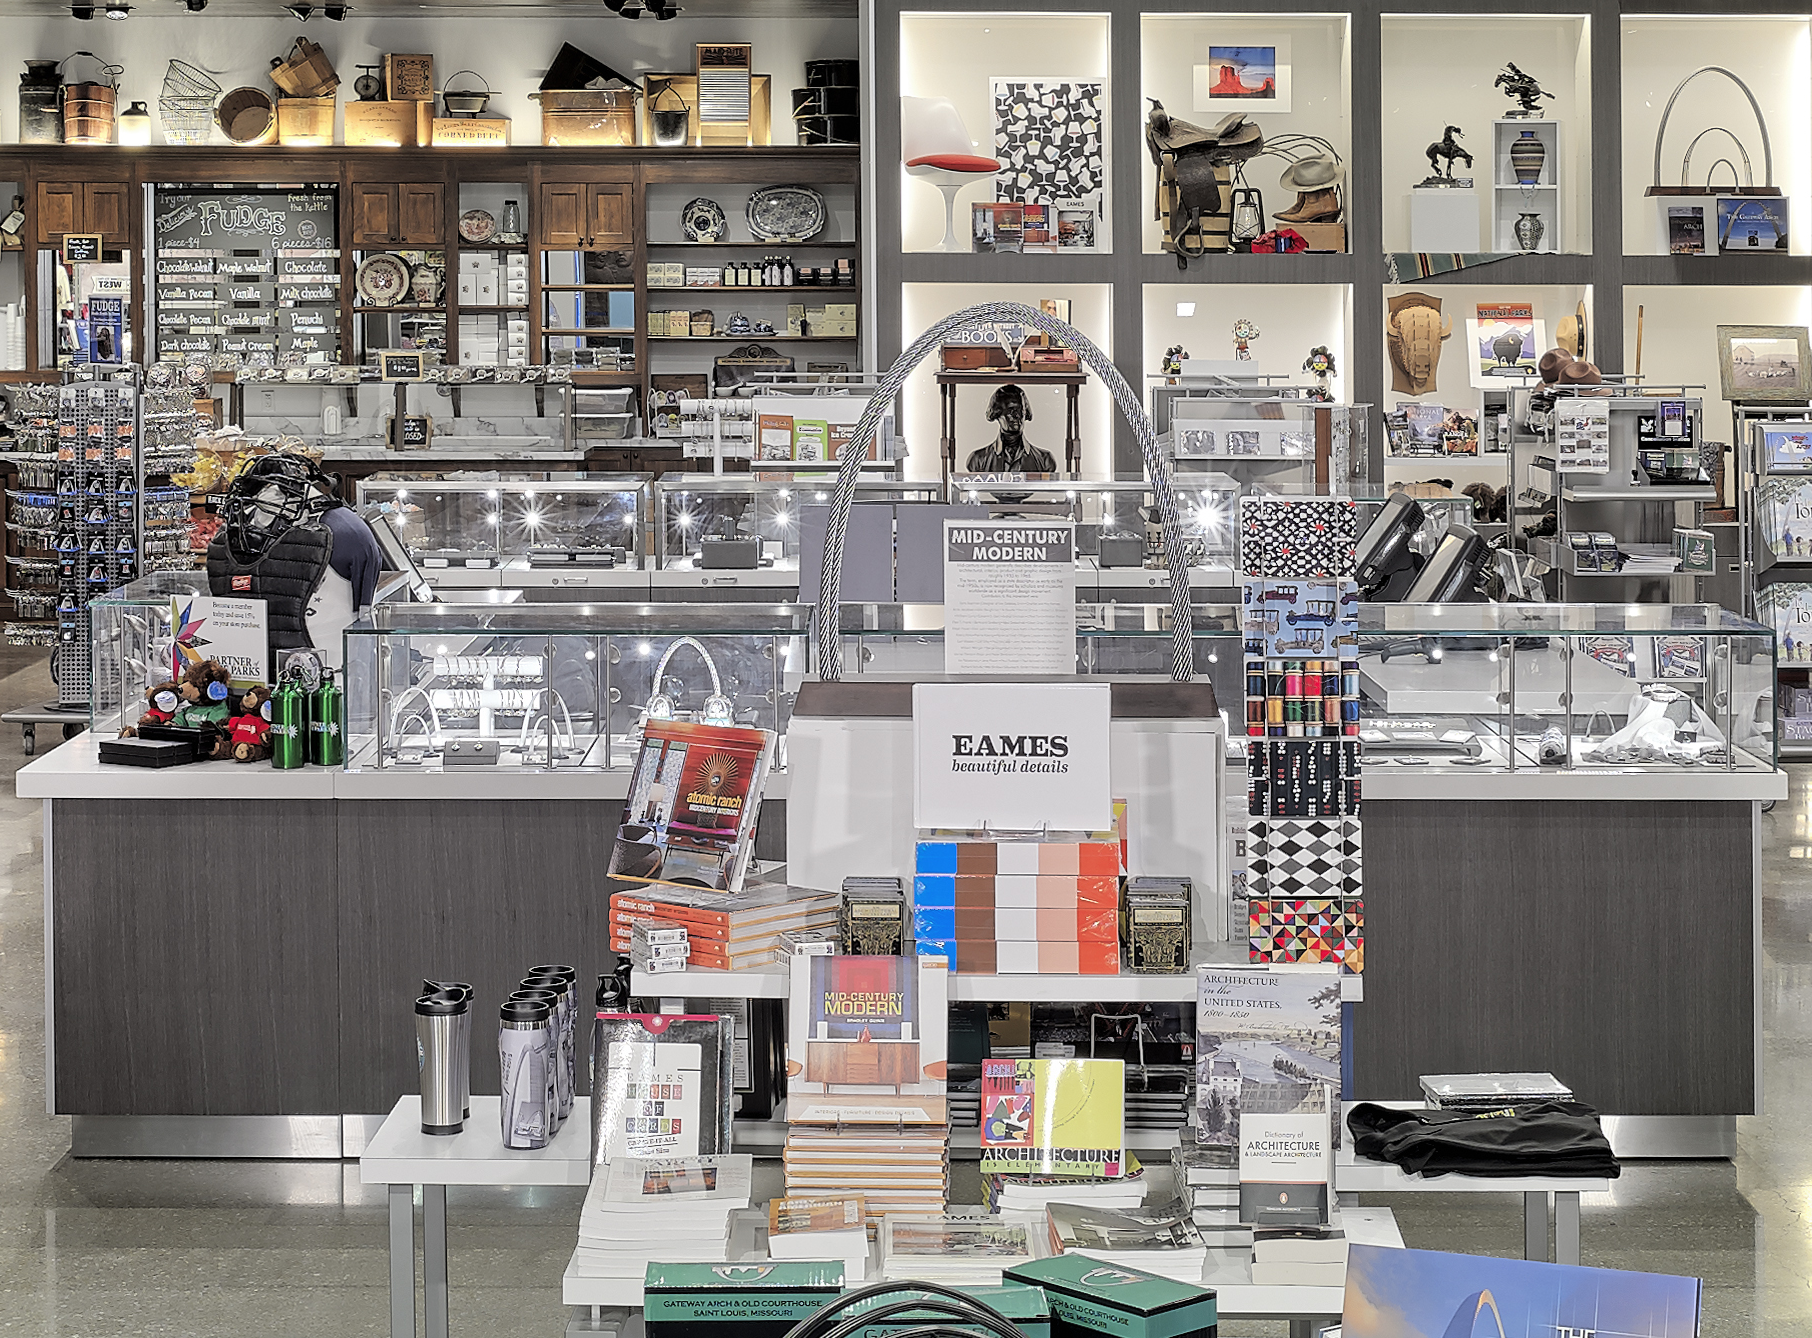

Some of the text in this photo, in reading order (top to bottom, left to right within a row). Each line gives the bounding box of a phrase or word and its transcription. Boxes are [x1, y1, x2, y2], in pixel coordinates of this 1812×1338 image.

[159, 192, 174, 207] Try
[290, 202, 302, 212] the
[197, 200, 286, 236] FUDGE
[158, 237, 163, 247] 1
[271, 237, 279, 248] 6
[216, 262, 243, 275] Maple
[285, 260, 327, 273] Chocolate
[158, 287, 186, 299] Vanilla
[228, 286, 261, 299] Vanilla
[280, 285, 300, 299] Milk
[90, 300, 120, 312] FUDGE
[160, 340, 179, 351] Dark
[221, 337, 246, 351] Peanut
[290, 337, 318, 351] Maple
[951, 529, 1068, 544] MID-CENTURY
[972, 546, 1047, 560] MODERN
[951, 733, 1069, 758] EAMES
[951, 758, 1068, 776] beautiful details
[686, 791, 742, 809] atomic ranch
[1204, 984, 1231, 996] in the
[824, 991, 904, 1003] MID-CENTURY
[1204, 997, 1282, 1010] UNITED STATES,
[824, 1001, 903, 1015] MODERN
[1264, 1130, 1304, 1139] Dictionary of
[1246, 1140, 1320, 1151] ARCHITECTURE
[981, 1147, 1120, 1164] ARCHITECTURE
[663, 1300, 705, 1308] GATEWAY
[706, 1300, 732, 1308] ARCH
[761, 1299, 823, 1307] COURTHOUSE
[693, 1309, 793, 1317] SAINT LOUIS, MISSOURI
